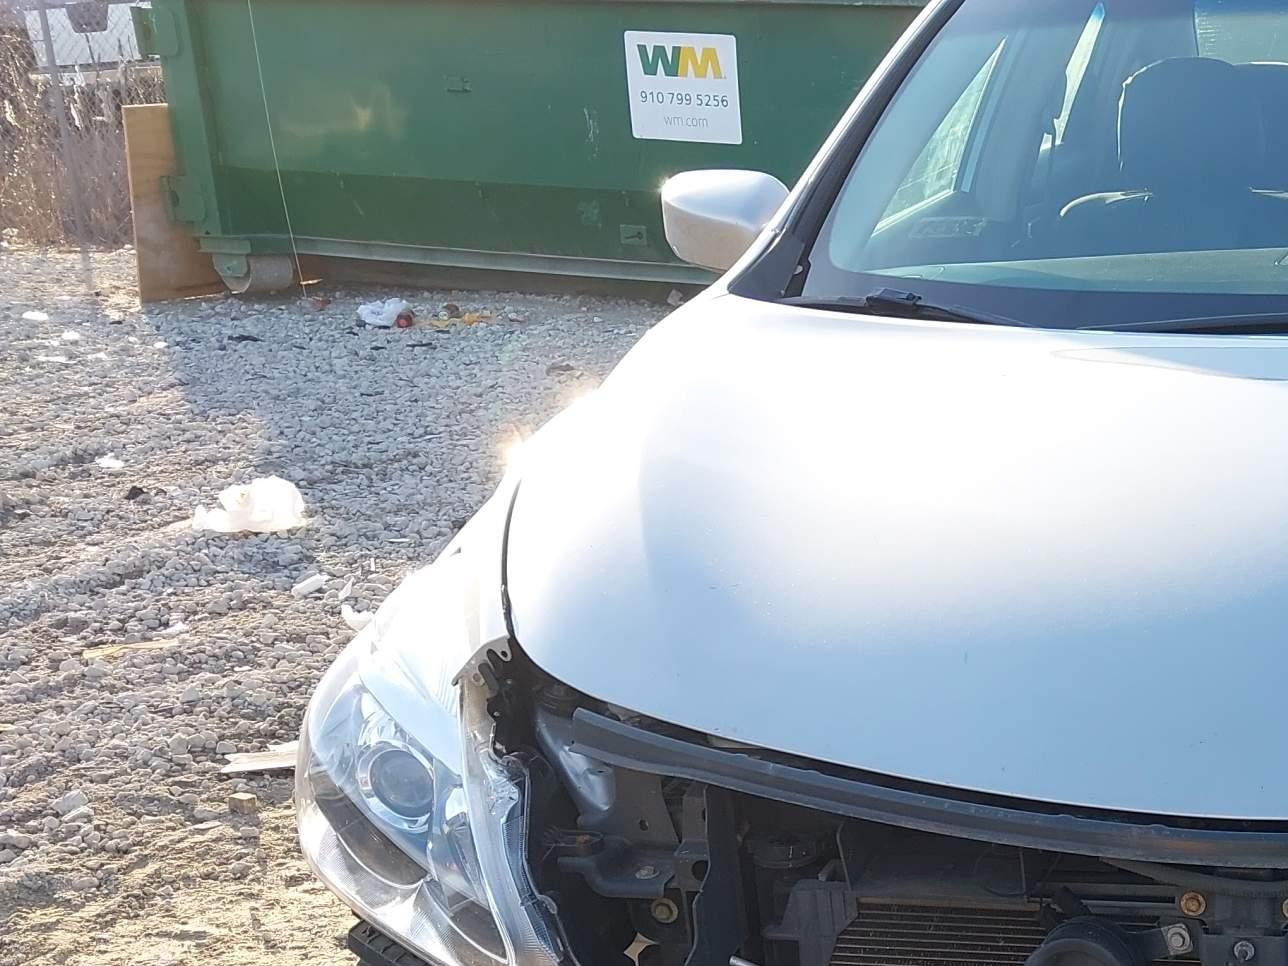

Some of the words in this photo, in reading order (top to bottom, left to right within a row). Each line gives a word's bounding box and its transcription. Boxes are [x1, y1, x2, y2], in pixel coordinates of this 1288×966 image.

[636, 43, 723, 79] WM
[640, 90, 665, 105] 910
[668, 92, 692, 106] 799
[696, 94, 729, 108] 5256
